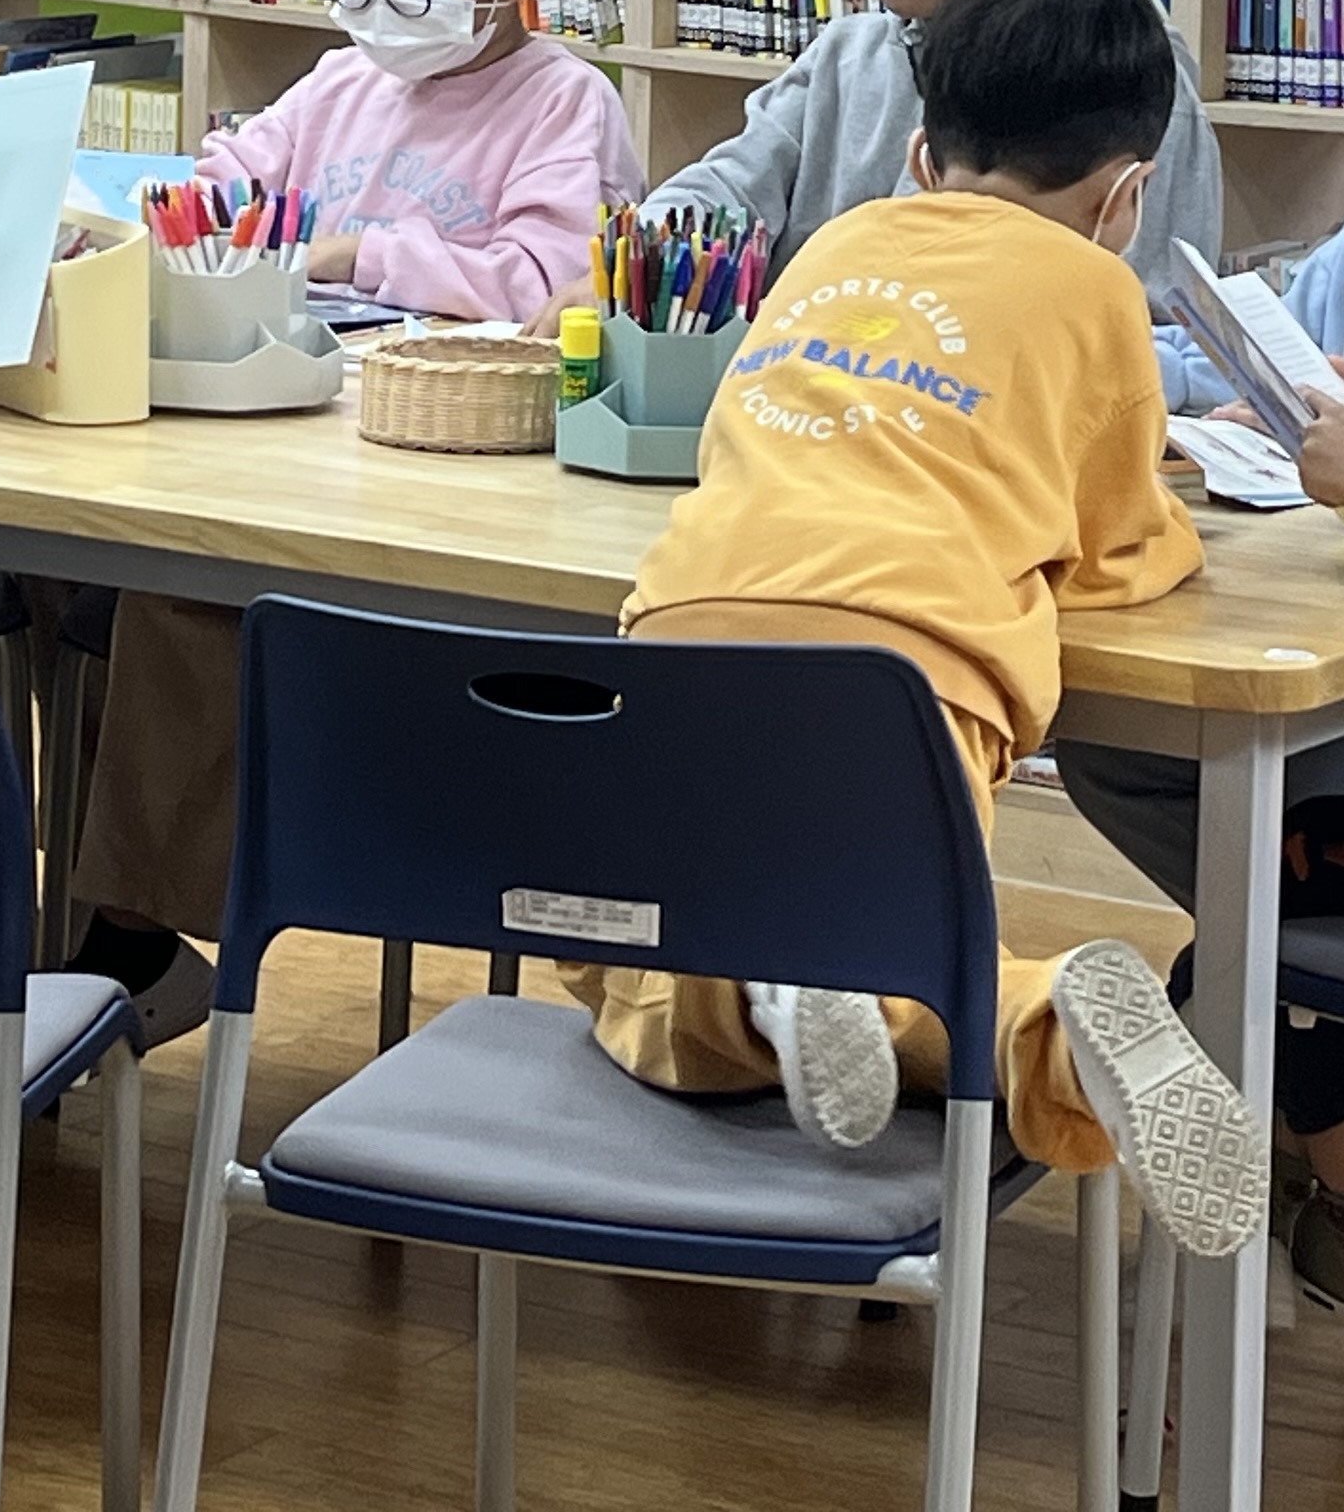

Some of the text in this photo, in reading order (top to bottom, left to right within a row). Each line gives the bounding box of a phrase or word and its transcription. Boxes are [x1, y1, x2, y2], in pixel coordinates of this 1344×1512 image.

[772, 277, 968, 355] SPORTS CLUB
[739, 383, 836, 441] ICONIC
[801, 338, 992, 417] BALANCE
